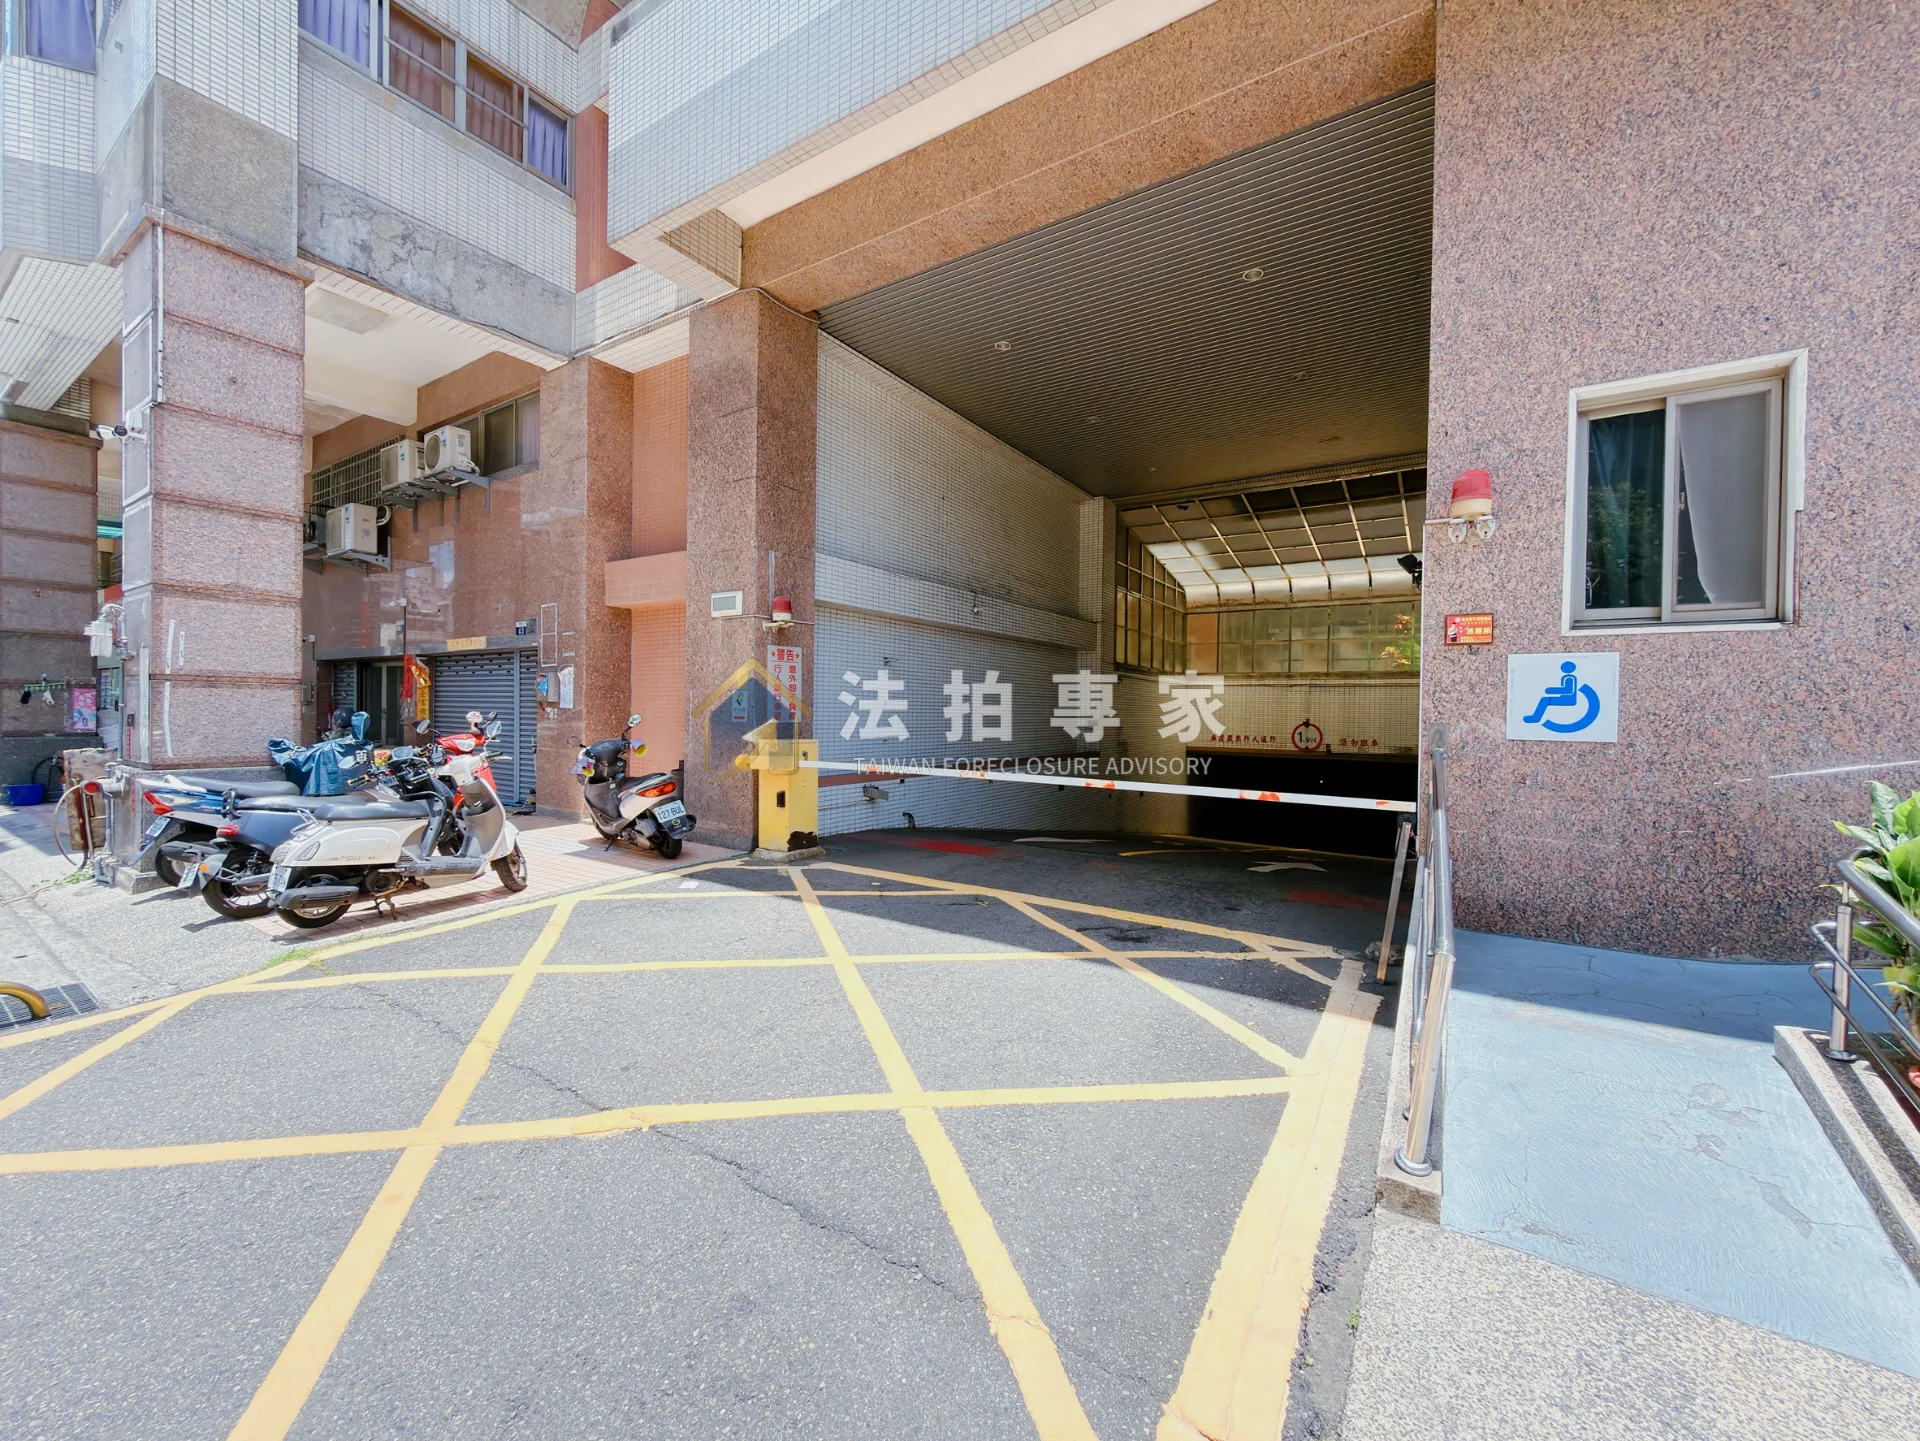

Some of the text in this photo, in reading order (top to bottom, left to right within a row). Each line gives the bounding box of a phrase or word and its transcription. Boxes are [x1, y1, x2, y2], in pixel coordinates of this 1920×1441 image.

[776, 648, 794, 661] 警告
[788, 665, 797, 720] 意外恕不負責
[657, 805, 685, 820] 127-BUL
